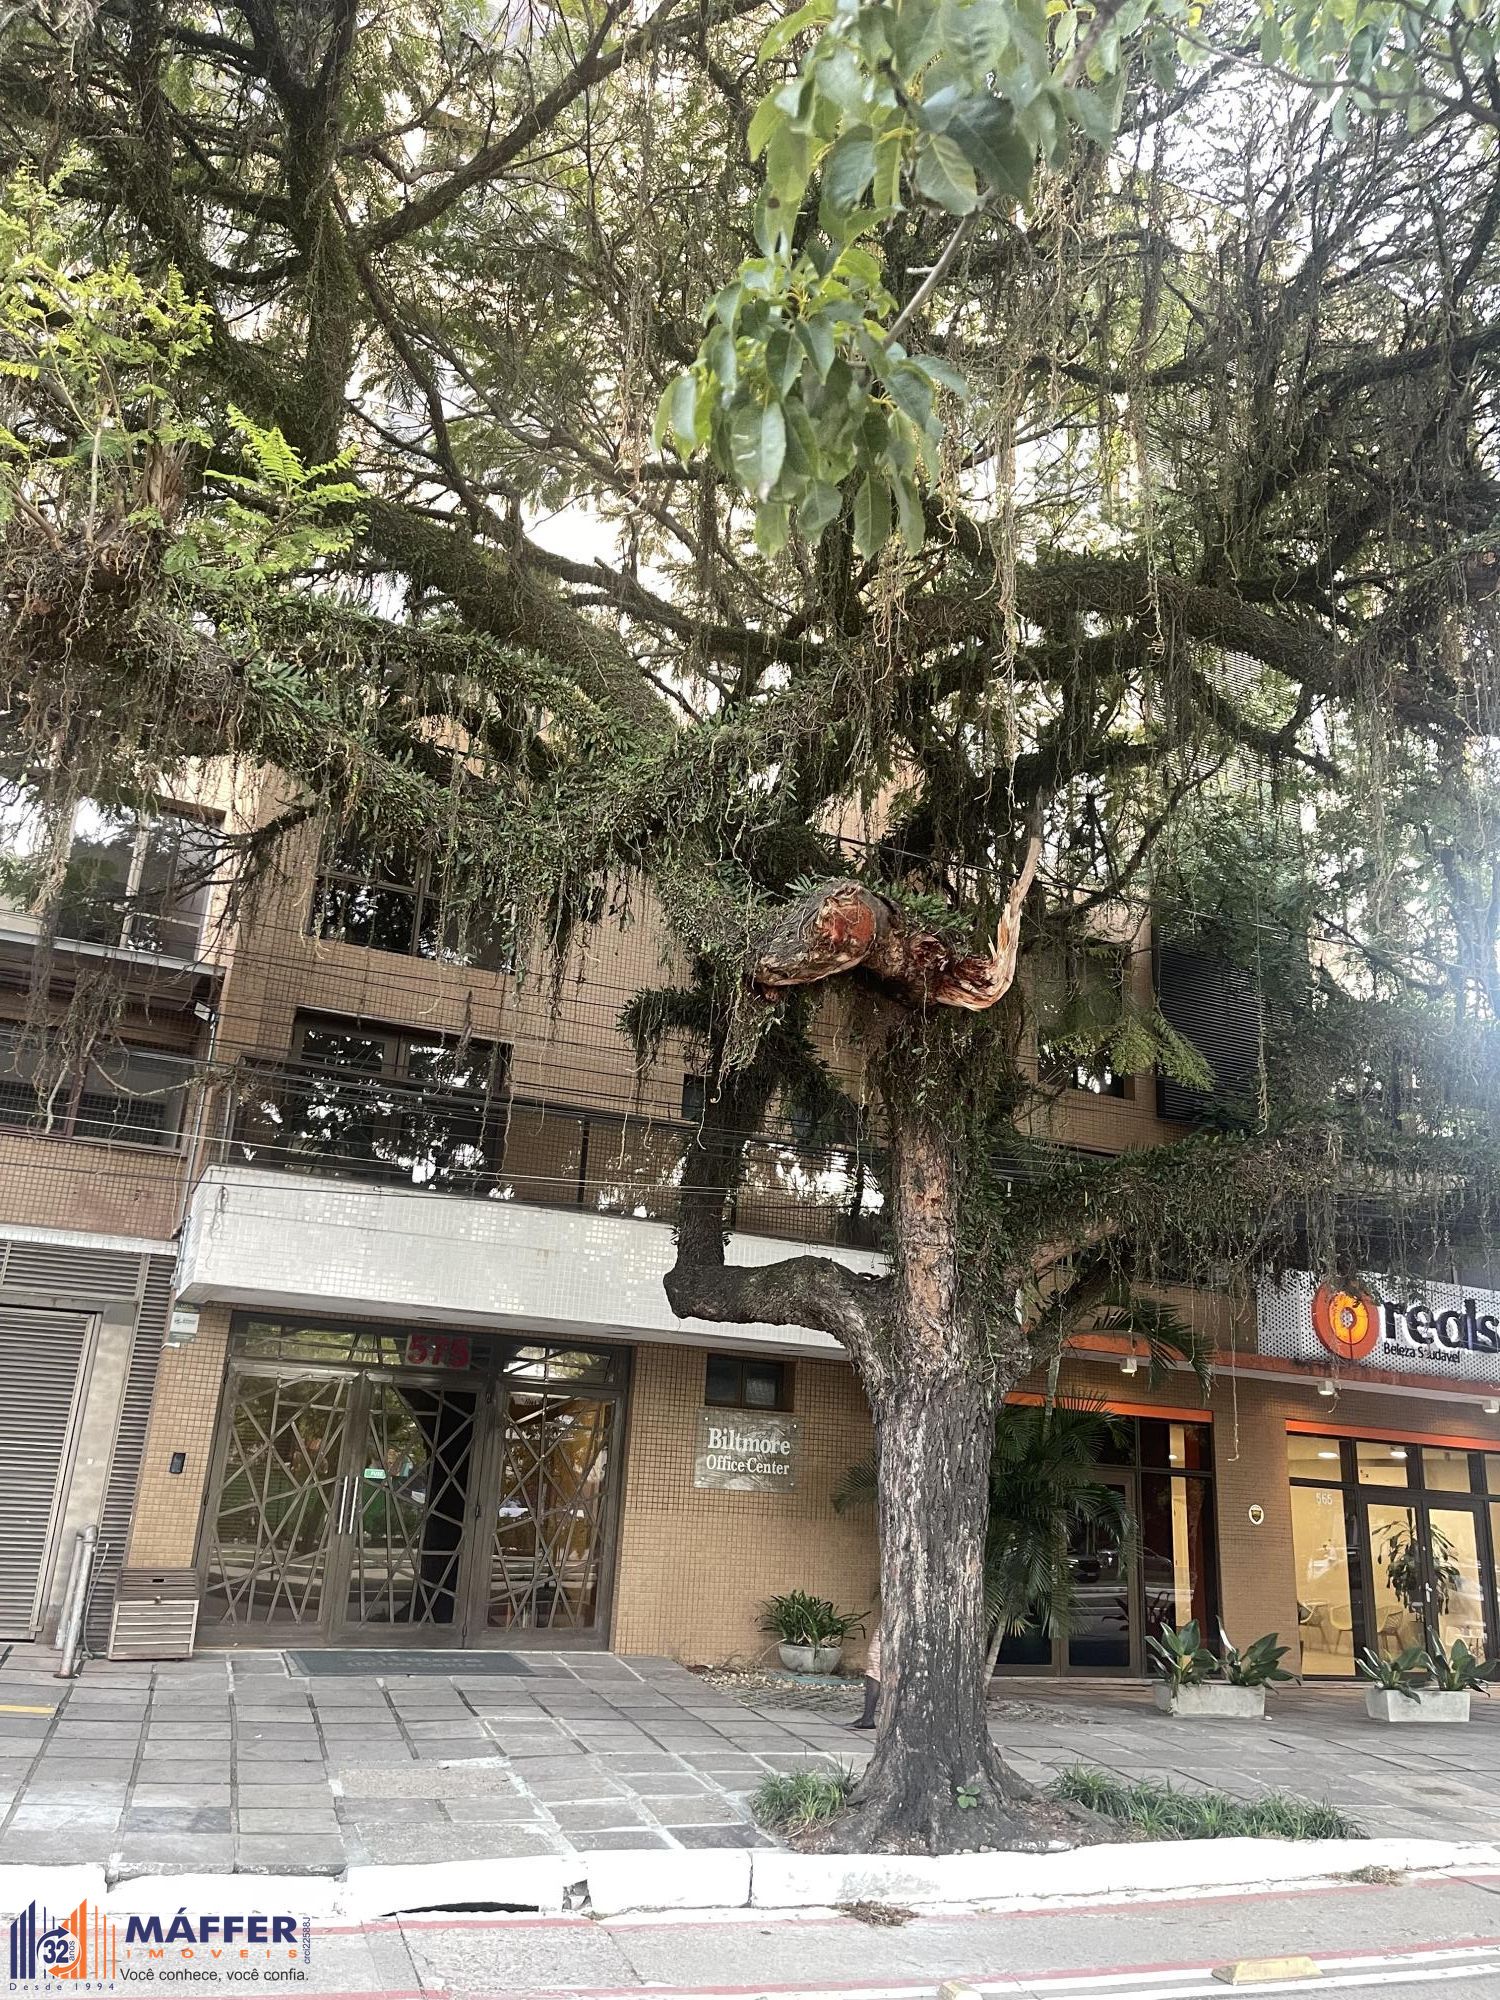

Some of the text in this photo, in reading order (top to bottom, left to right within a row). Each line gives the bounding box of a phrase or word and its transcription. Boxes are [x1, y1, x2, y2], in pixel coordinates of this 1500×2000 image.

[1384, 1341, 1416, 1358] Beleza
[708, 1427, 790, 1455] Biltmore
[706, 1455, 789, 1474] Office Center
